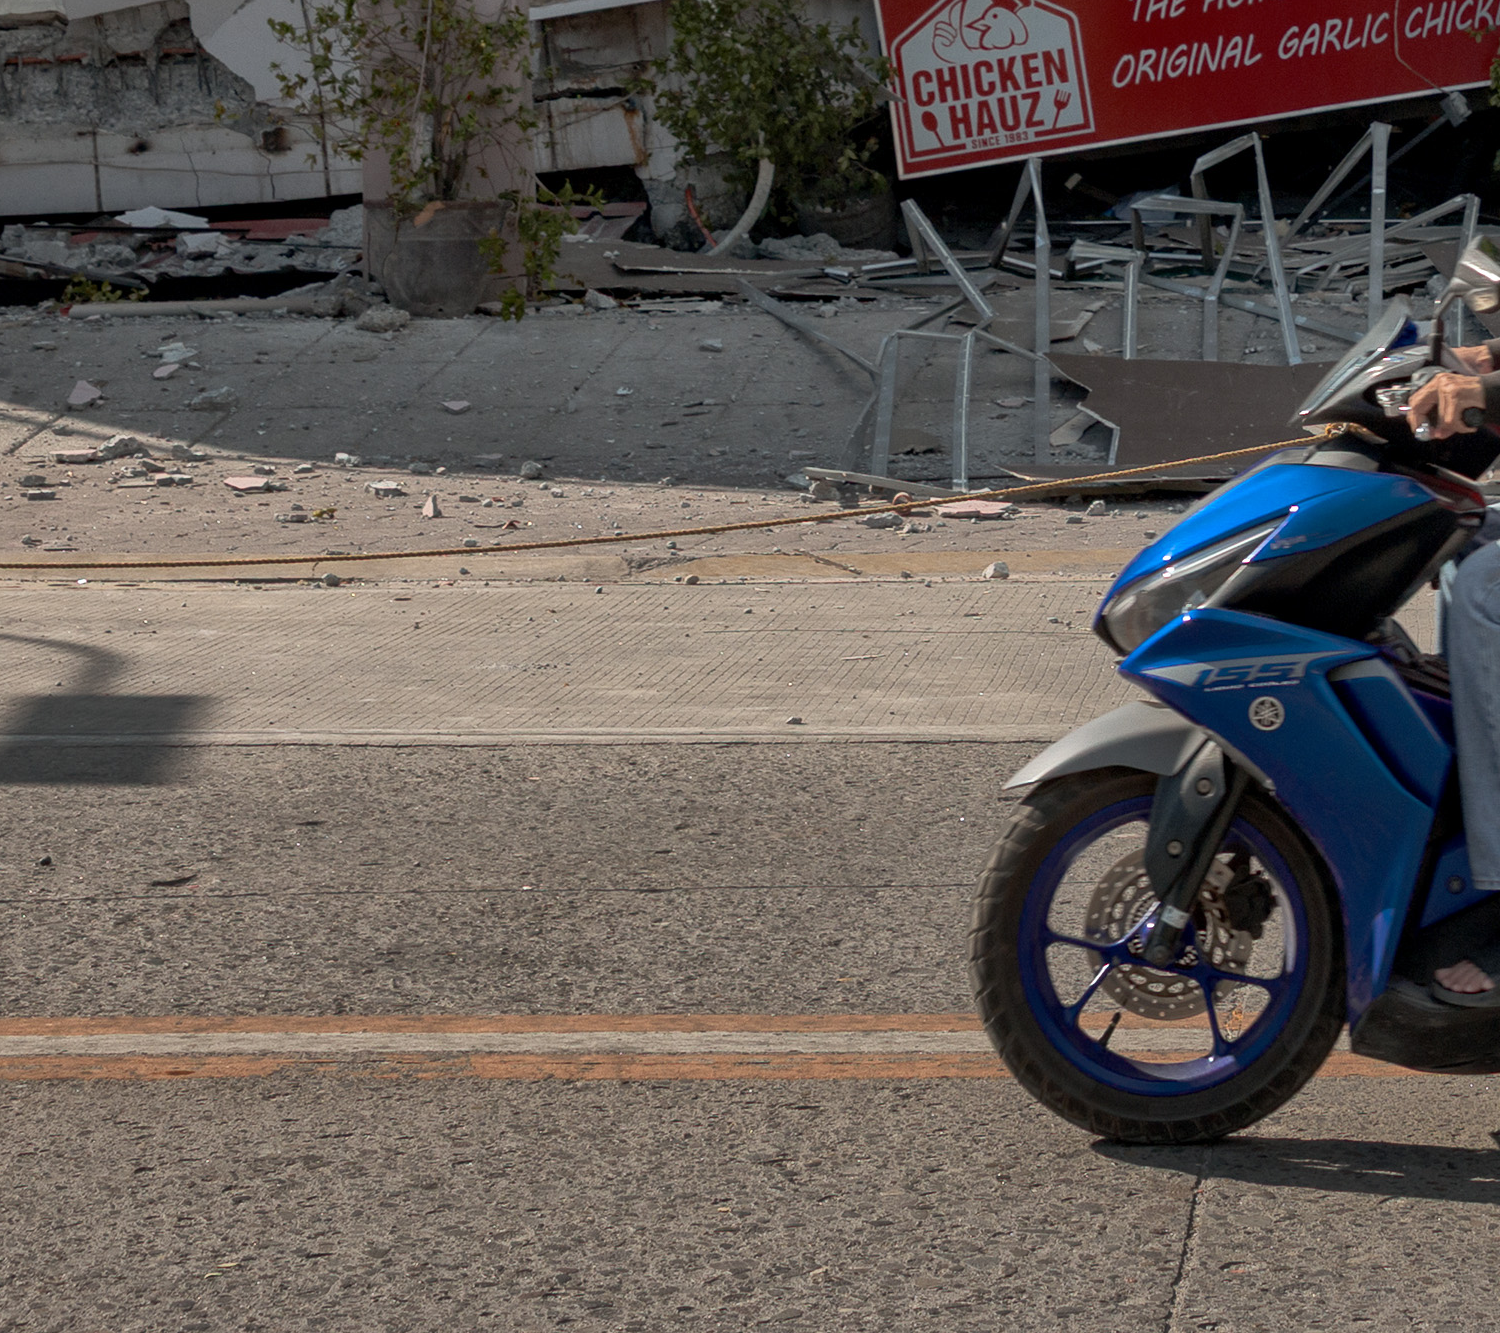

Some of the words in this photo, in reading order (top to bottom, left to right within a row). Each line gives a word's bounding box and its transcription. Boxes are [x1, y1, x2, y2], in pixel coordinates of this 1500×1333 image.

[1111, 34, 1263, 89] ORIGINAL
[1278, 11, 1390, 60] GARLIC
[912, 49, 1069, 107] CHICKEN
[949, 92, 1045, 140] HAUZ
[971, 134, 1001, 150] SINCE
[1004, 130, 1029, 144] 1983
[1193, 662, 1302, 686] 155
